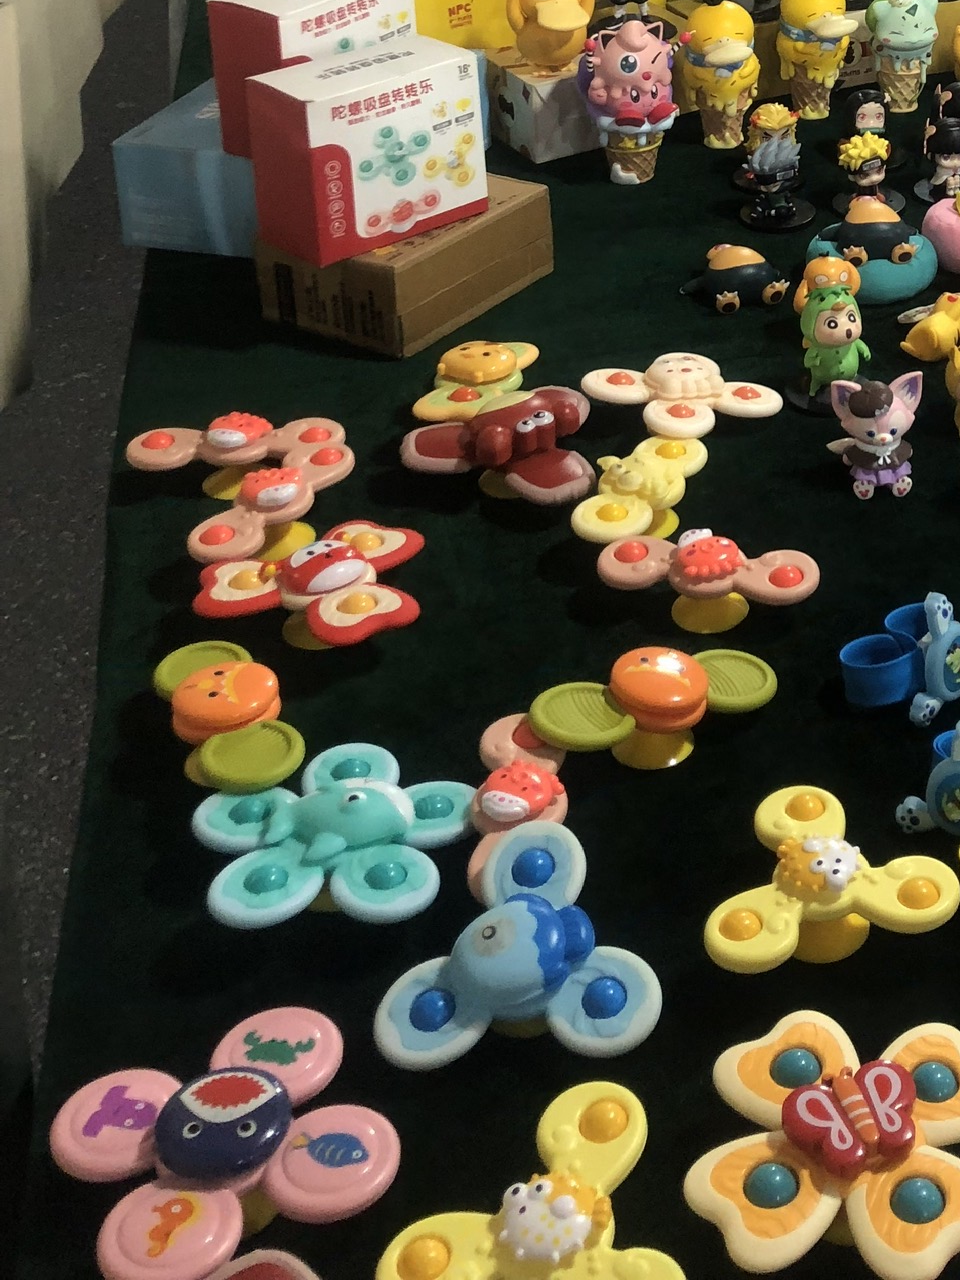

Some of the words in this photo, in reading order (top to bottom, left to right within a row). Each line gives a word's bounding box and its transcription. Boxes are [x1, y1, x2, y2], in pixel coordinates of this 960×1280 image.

[447, 2, 472, 18] NPC
[330, 78, 435, 122] 陀螺吸盘转转乐
